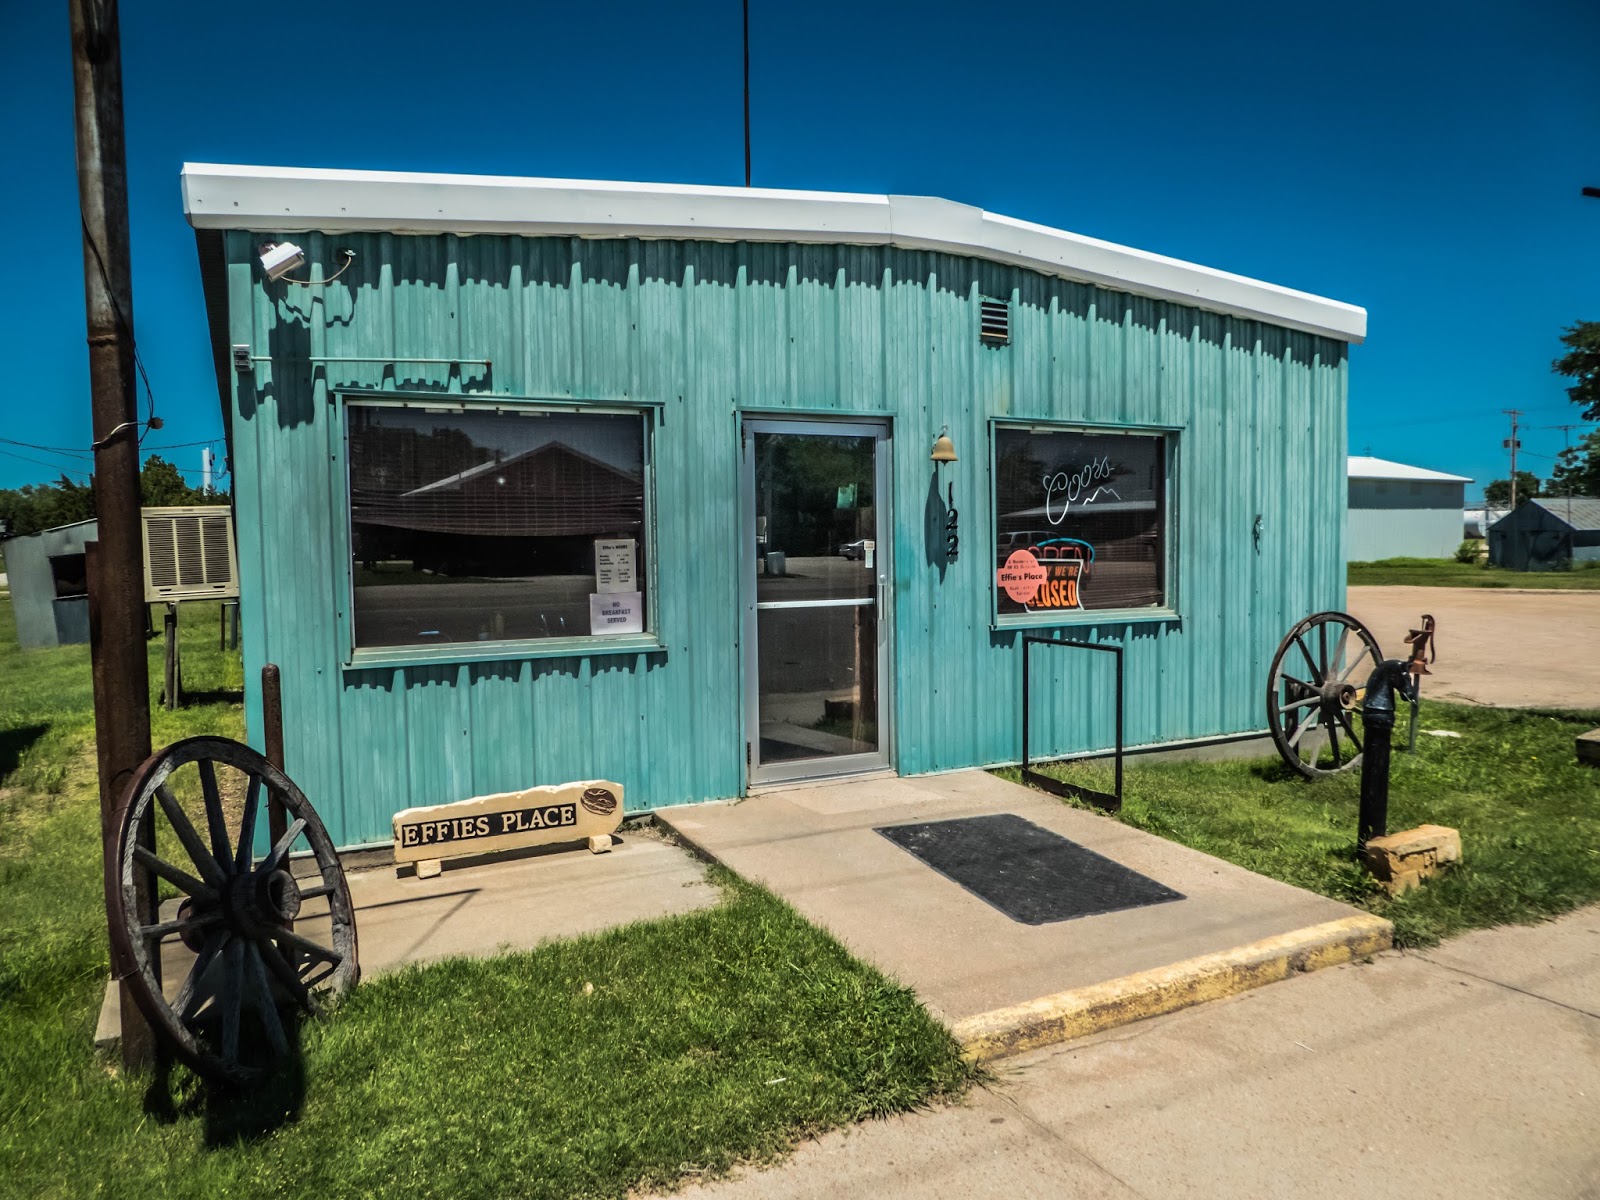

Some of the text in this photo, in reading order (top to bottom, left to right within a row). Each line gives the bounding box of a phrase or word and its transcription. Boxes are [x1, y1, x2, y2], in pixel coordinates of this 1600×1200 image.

[1024, 572, 1043, 580] Place
[1055, 566, 1079, 577] WE'RE
[1027, 580, 1077, 607] OSED
[403, 806, 575, 846] EFFIES PLACE
